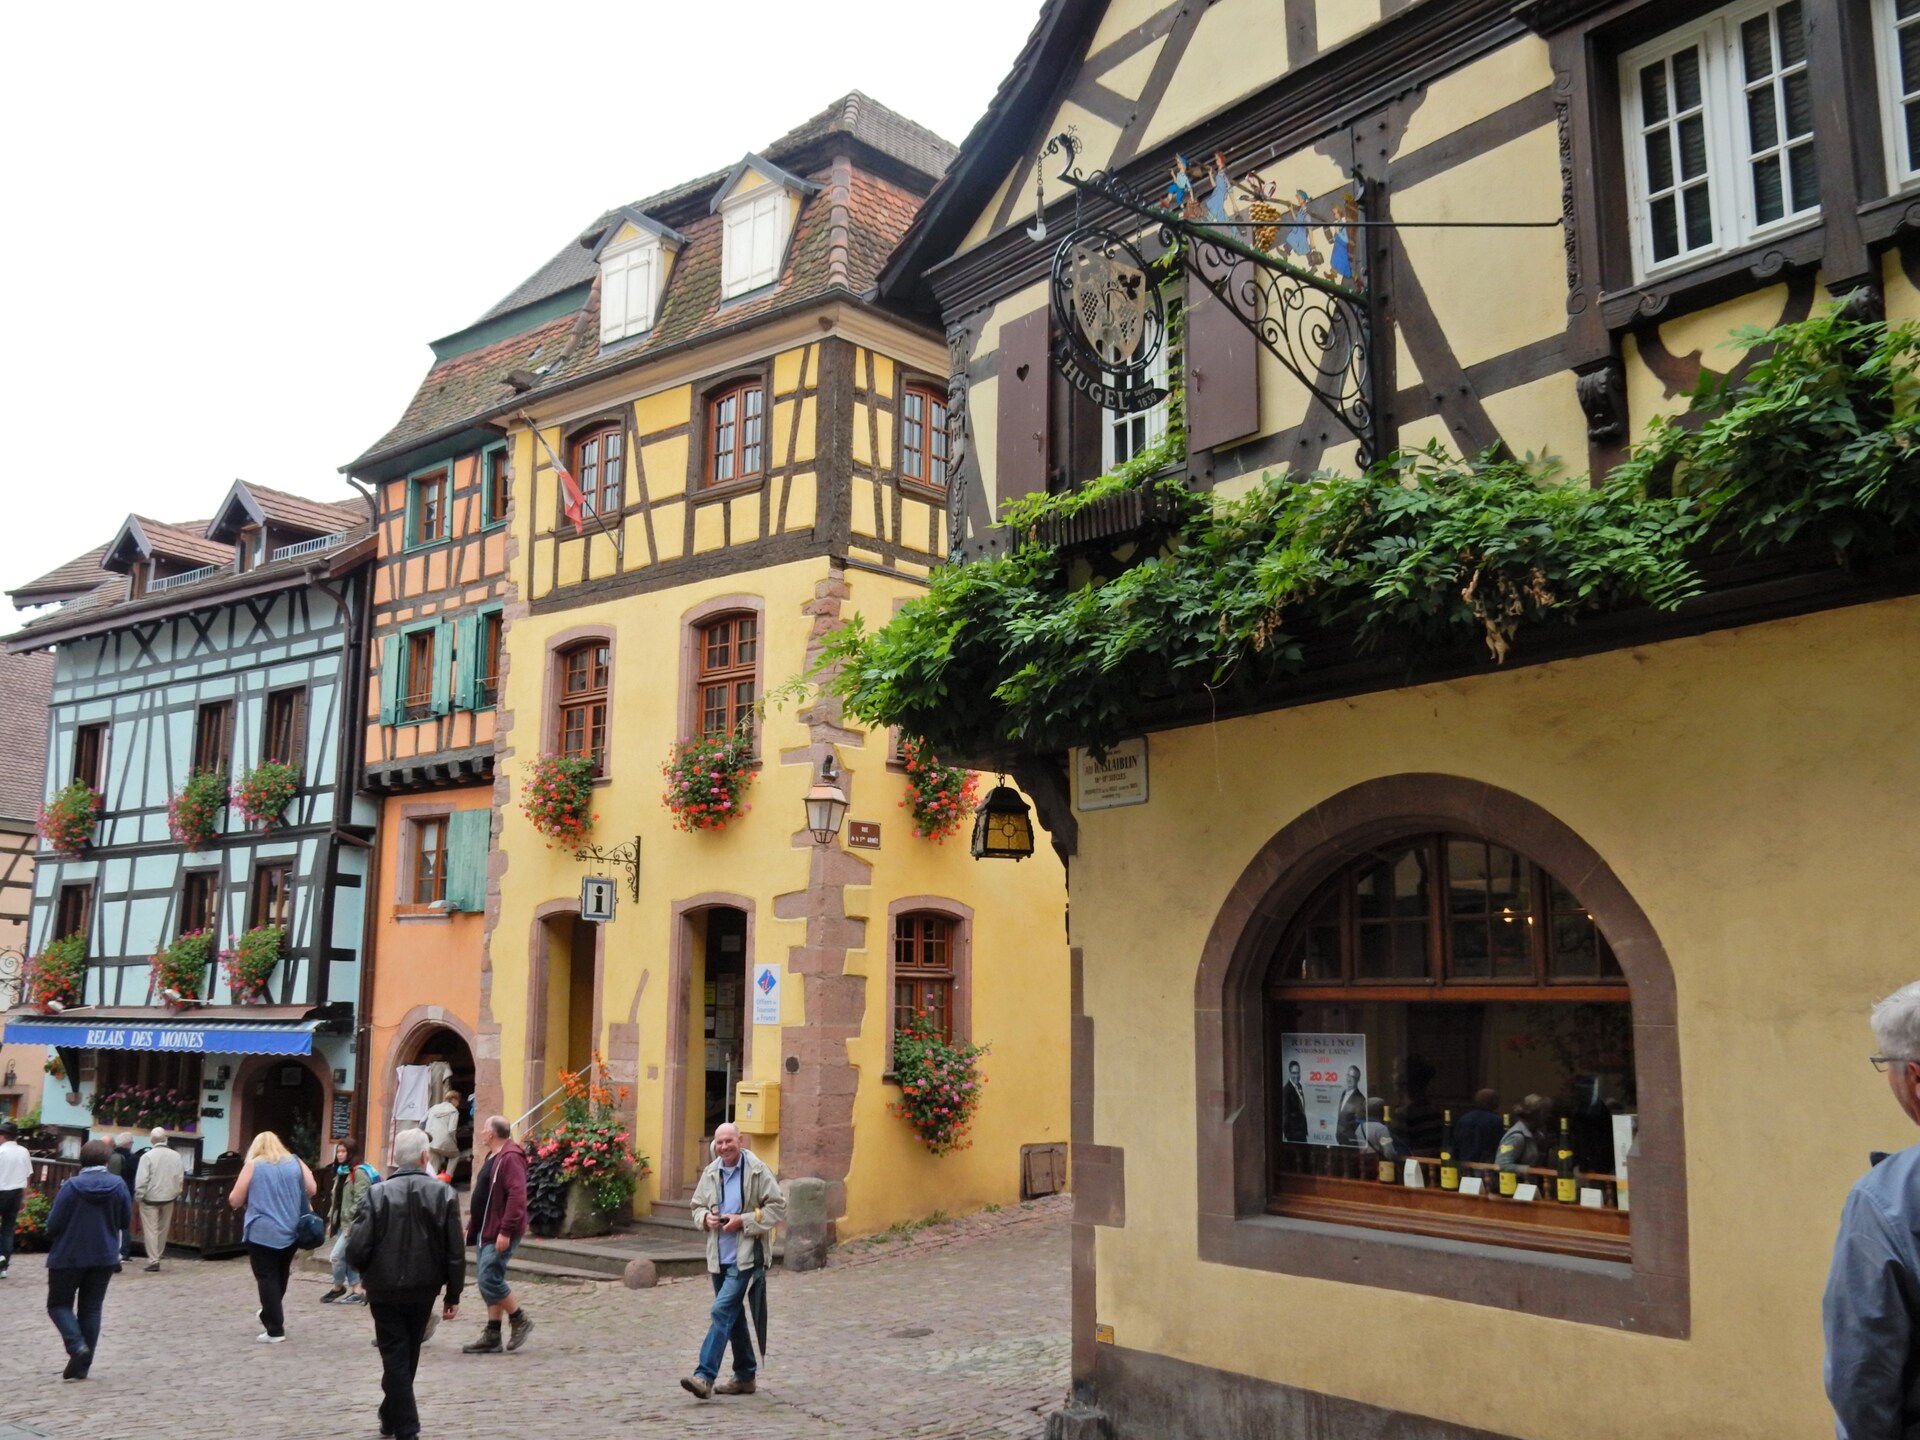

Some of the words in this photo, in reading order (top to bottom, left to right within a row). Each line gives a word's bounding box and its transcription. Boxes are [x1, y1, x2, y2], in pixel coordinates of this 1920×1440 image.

[1137, 392, 1158, 408] 1639
[594, 885, 604, 913] i
[86, 1030, 126, 1045] RELAIS
[130, 1031, 154, 1047] DES
[159, 1032, 205, 1048] MOINES
[1291, 1038, 1355, 1047] RIESLING
